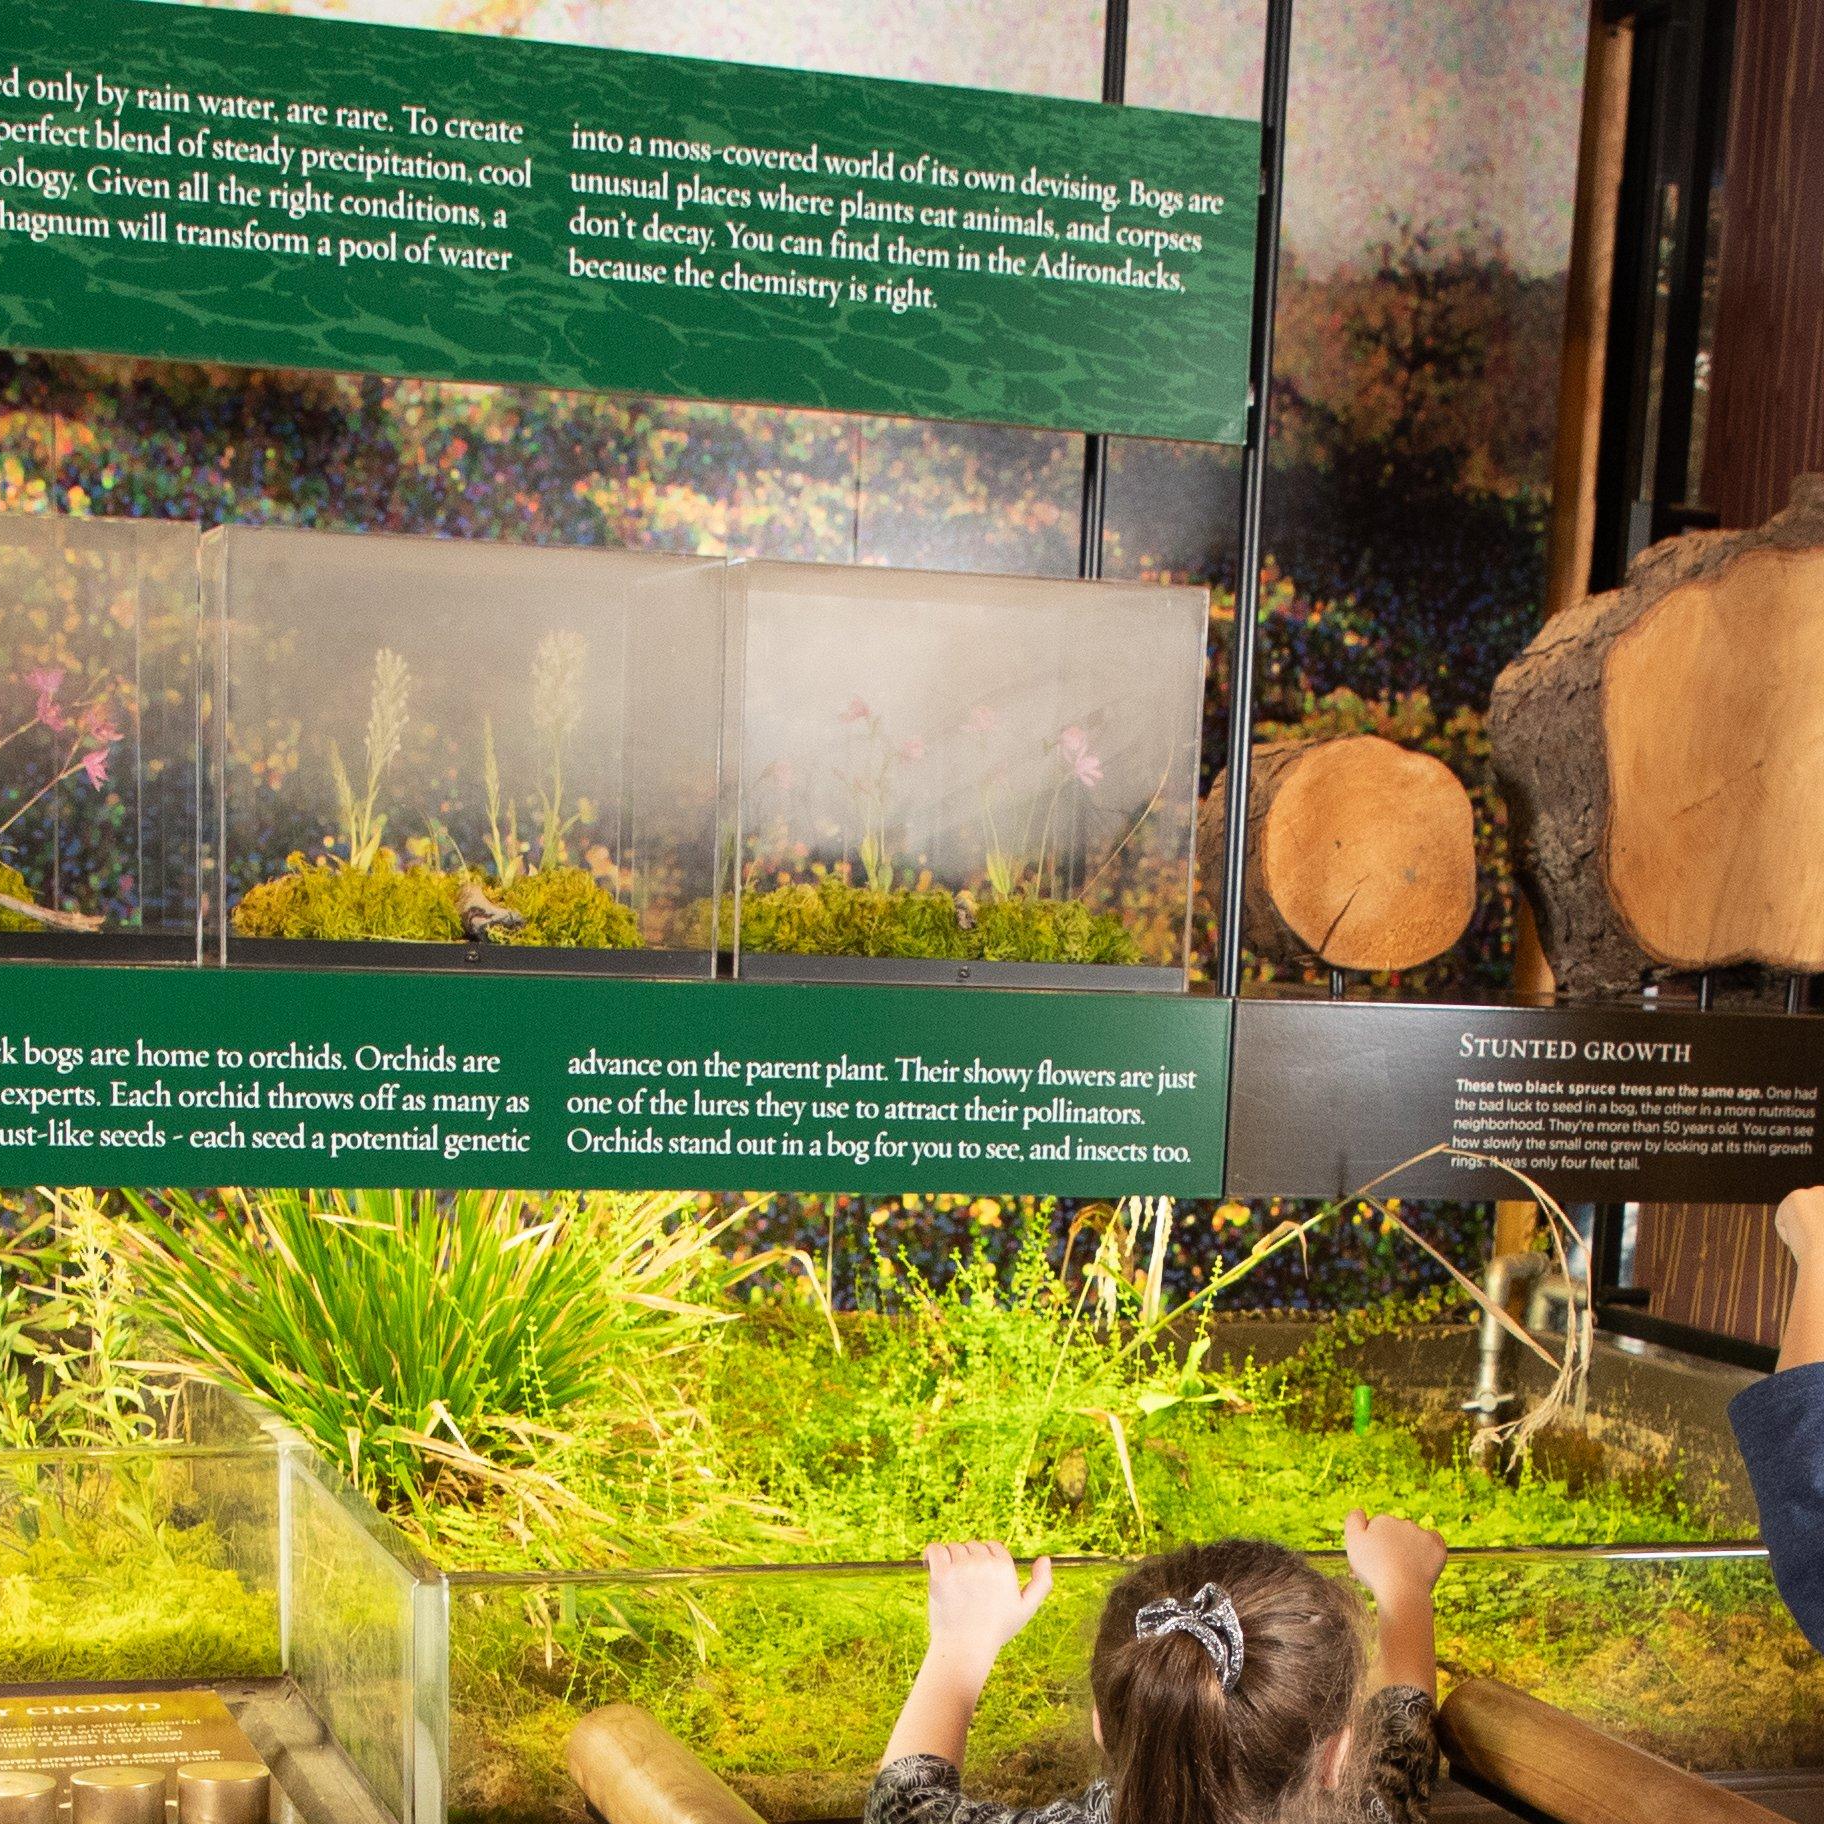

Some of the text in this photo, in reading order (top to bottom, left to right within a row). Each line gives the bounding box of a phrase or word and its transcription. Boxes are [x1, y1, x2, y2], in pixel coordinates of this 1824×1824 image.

[27, 71, 90, 112] only
[95, 74, 130, 115] by
[136, 83, 191, 113] rain
[197, 96, 280, 126] water,
[286, 103, 329, 126] are
[335, 107, 394, 133] rare.
[401, 105, 439, 136] To
[444, 118, 524, 145] create
[571, 121, 1225, 216] into a moss-covered world of its own devising. Bogs are
[23, 1036, 84, 1075] bogs
[89, 1047, 131, 1067] are
[136, 1038, 210, 1068] home
[216, 1048, 244, 1069] to
[248, 1041, 348, 1071] orchids.
[354, 1043, 457, 1073] Orchids
[462, 1055, 501, 1074] are
[1459, 1033, 1692, 1063] STUNTED GROWTH
[567, 1047, 1197, 1095] advance on the parent plant. Their showy flowers are just
[1455, 1078, 1818, 1101] These two black spruce trees are the same age. One had
[26, 1701, 162, 1716] CROWD
